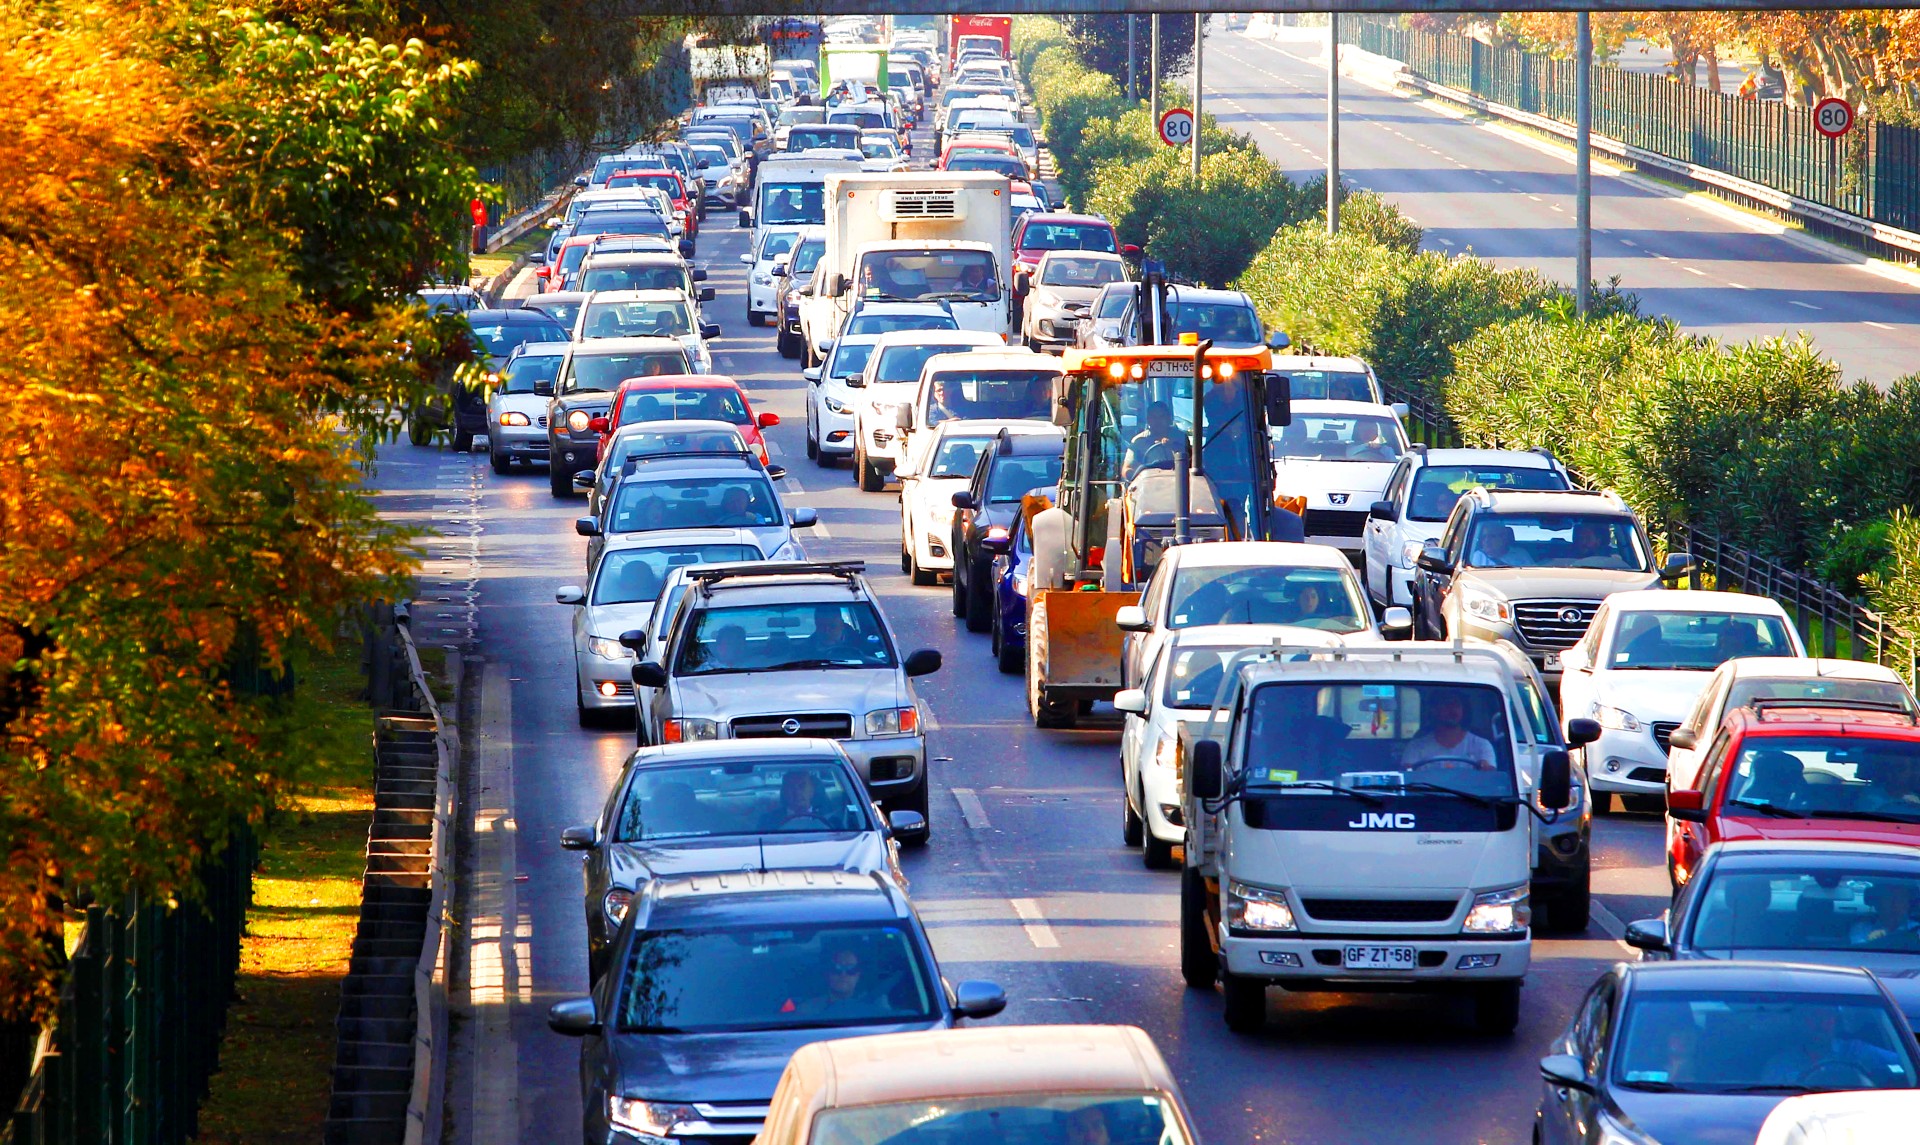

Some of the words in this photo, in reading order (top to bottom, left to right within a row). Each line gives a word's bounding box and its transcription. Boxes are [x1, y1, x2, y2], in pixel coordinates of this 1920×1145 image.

[1821, 109, 1846, 126] 80
[1167, 121, 1190, 137] 80
[1348, 813, 1416, 829] JMC
